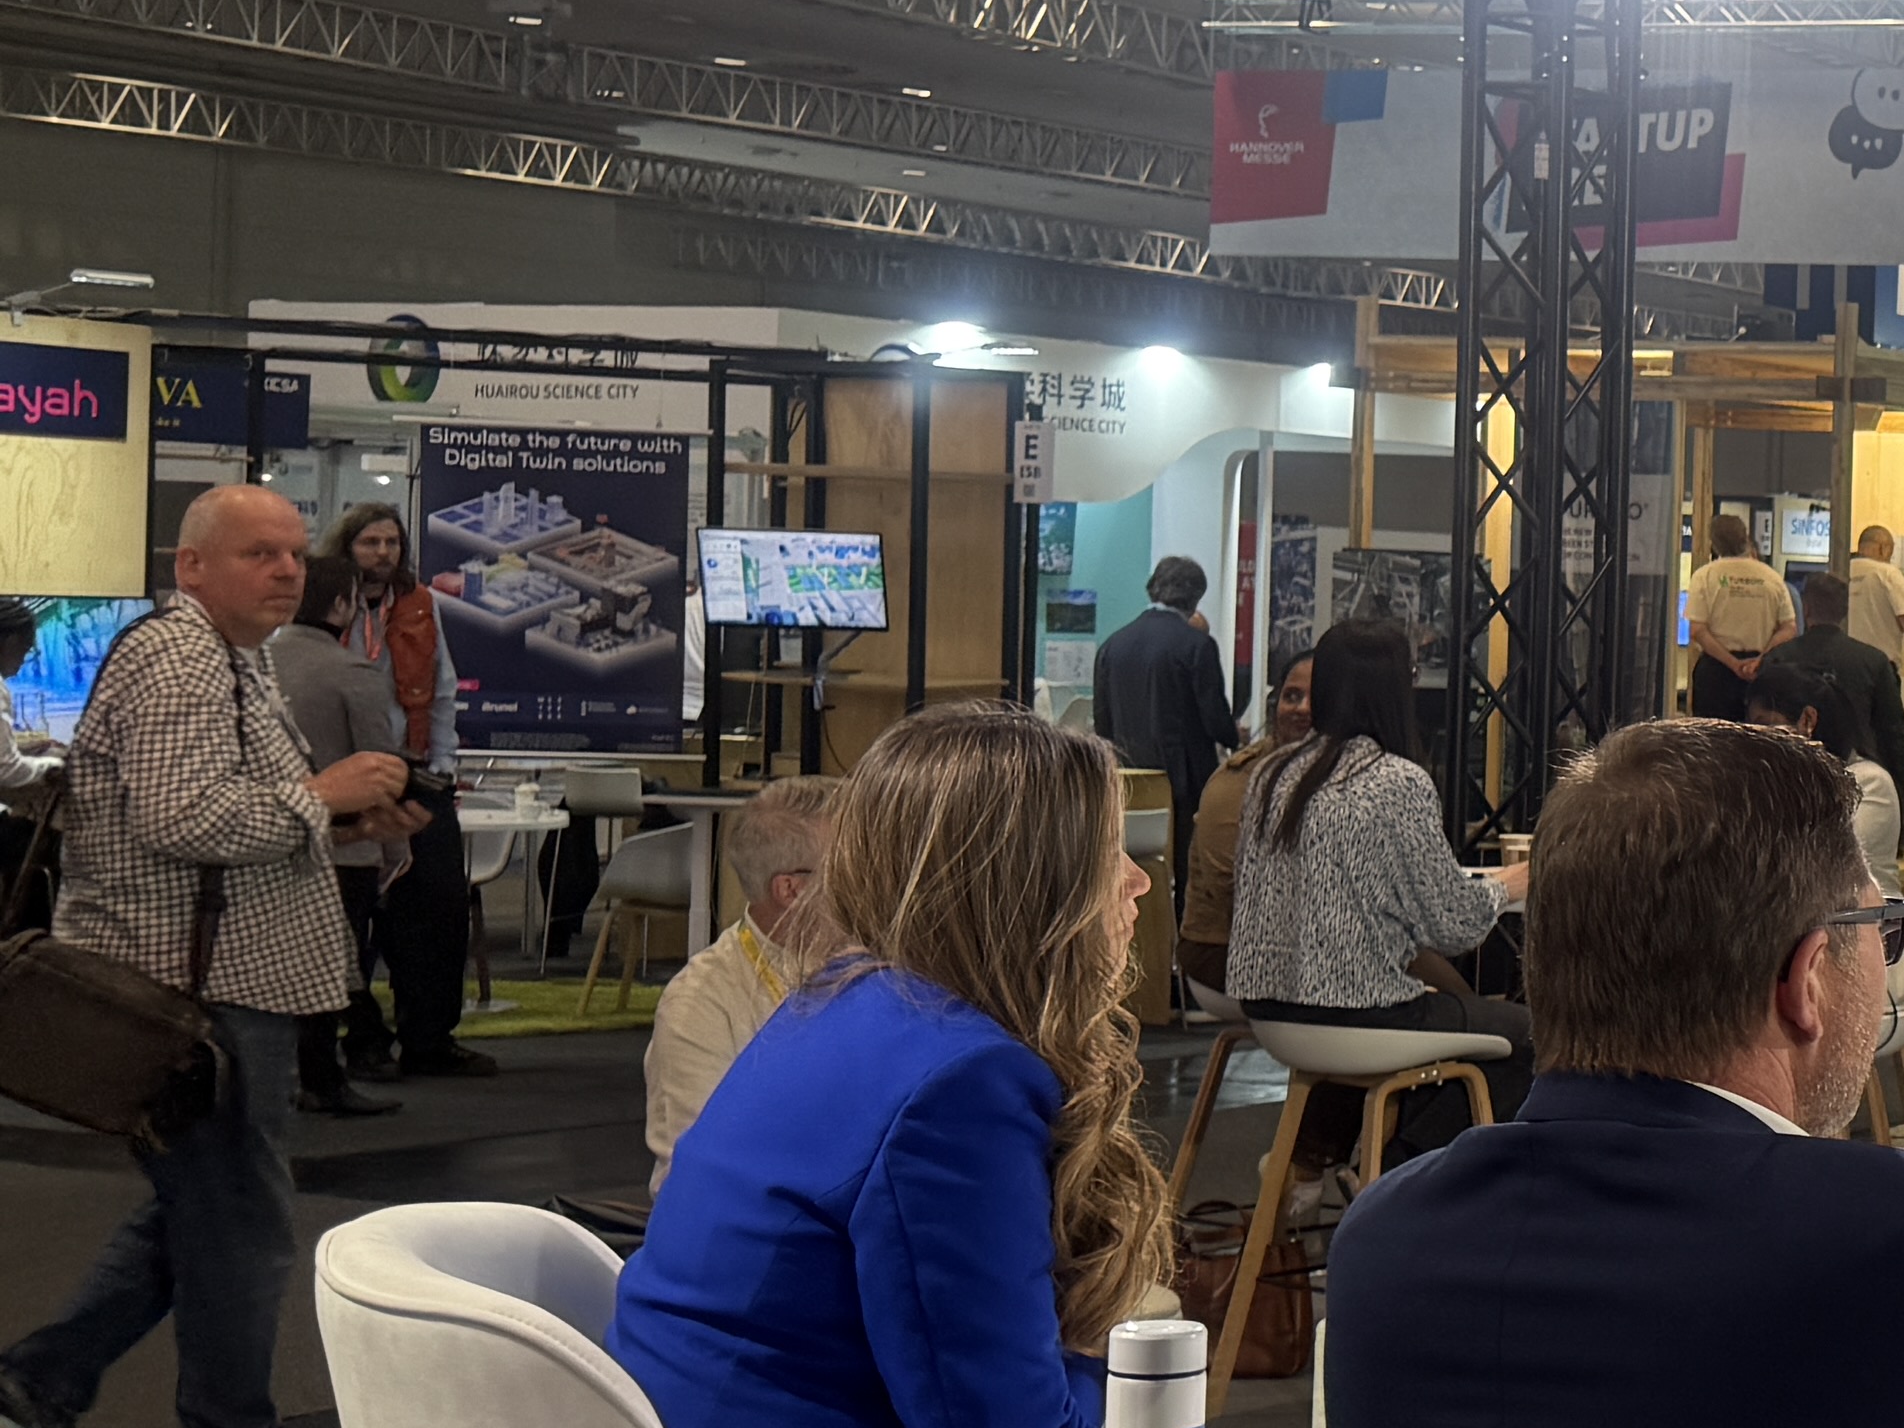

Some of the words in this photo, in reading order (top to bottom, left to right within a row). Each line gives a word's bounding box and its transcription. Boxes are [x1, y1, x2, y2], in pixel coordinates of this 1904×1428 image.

[1230, 141, 1304, 153] HANNOVER
[474, 383, 540, 400] HUAIROU
[543, 384, 603, 400] SCIENCE
[606, 383, 640, 399] CITY
[1097, 418, 1127, 434] CITY
[428, 427, 522, 448] Simulate
[527, 431, 560, 449] the
[566, 433, 628, 452] future
[637, 436, 682, 455] with
[1024, 434, 1039, 460] E
[444, 448, 513, 470] Digital
[518, 451, 566, 471] Twin
[572, 454, 666, 475] solutions
